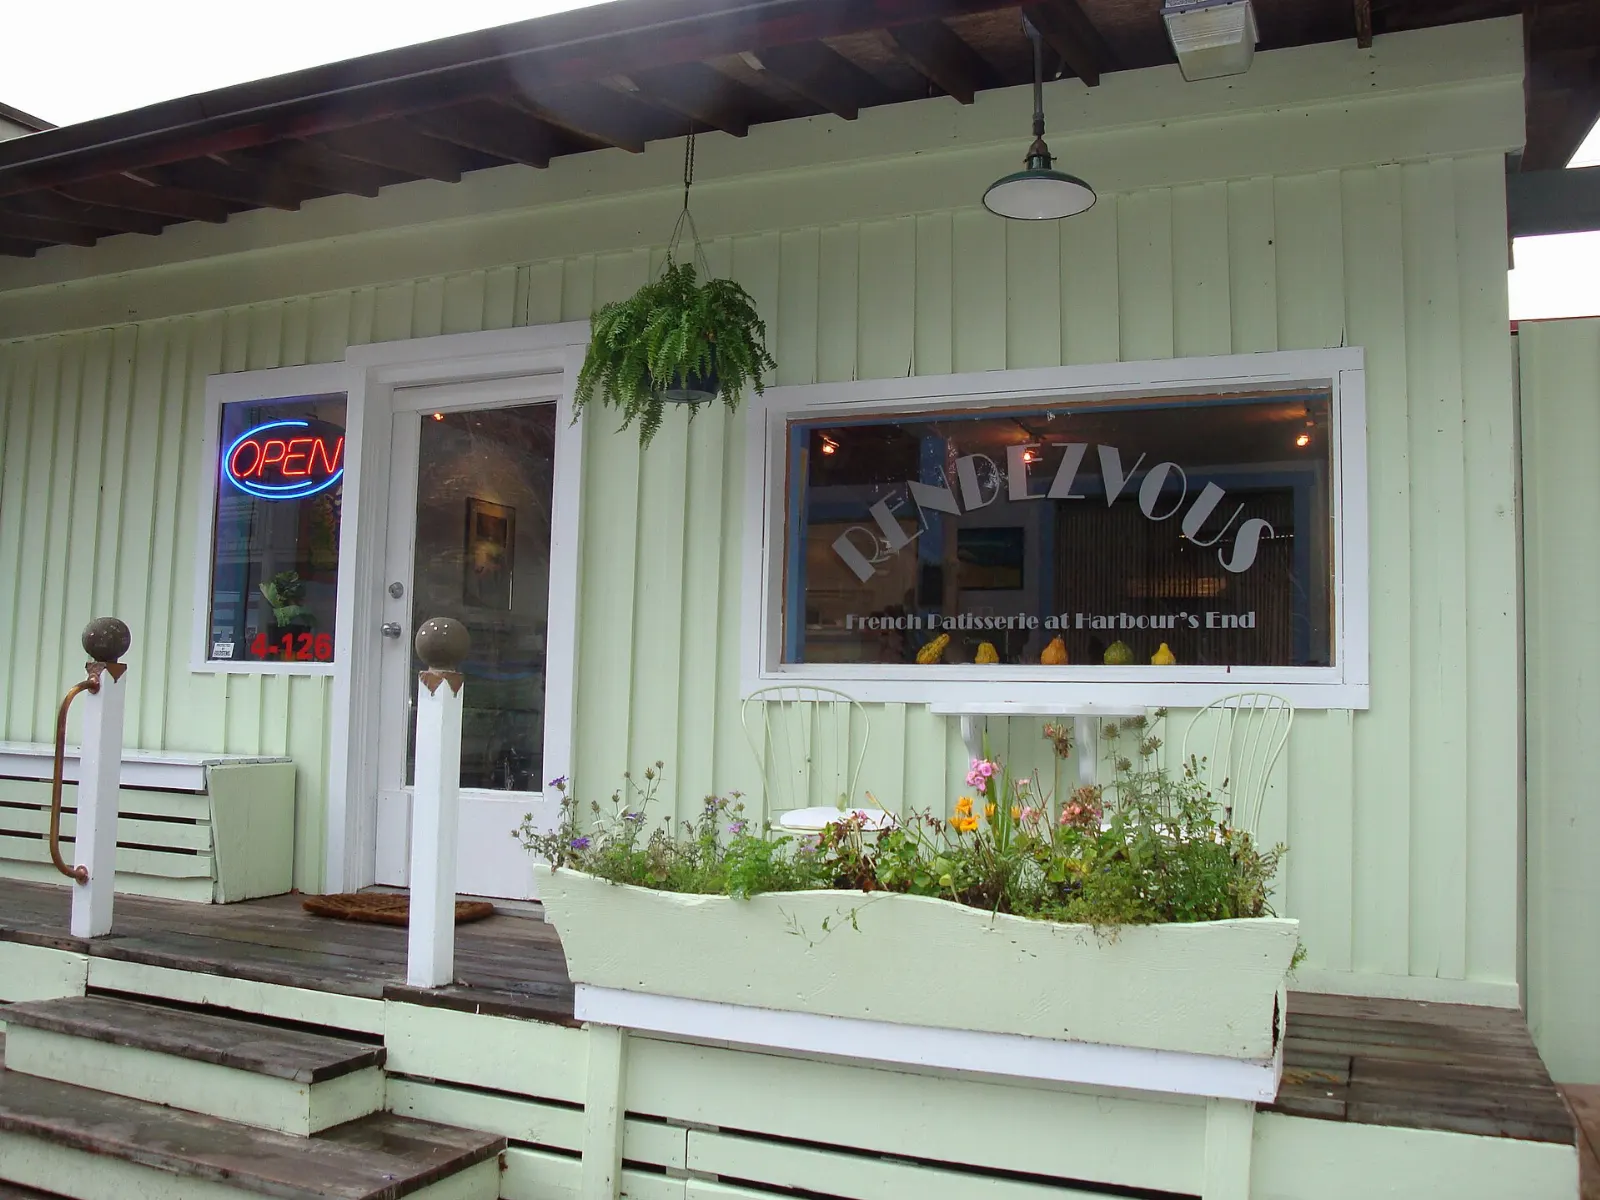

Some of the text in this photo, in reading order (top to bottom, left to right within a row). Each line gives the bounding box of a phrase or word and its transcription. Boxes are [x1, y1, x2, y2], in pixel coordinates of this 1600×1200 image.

[231, 437, 344, 477] OPEN
[831, 442, 1274, 583] RENDEZVOUS
[846, 611, 1256, 630] French Patisserie at Harbour's End
[250, 632, 332, 660] 4-126
